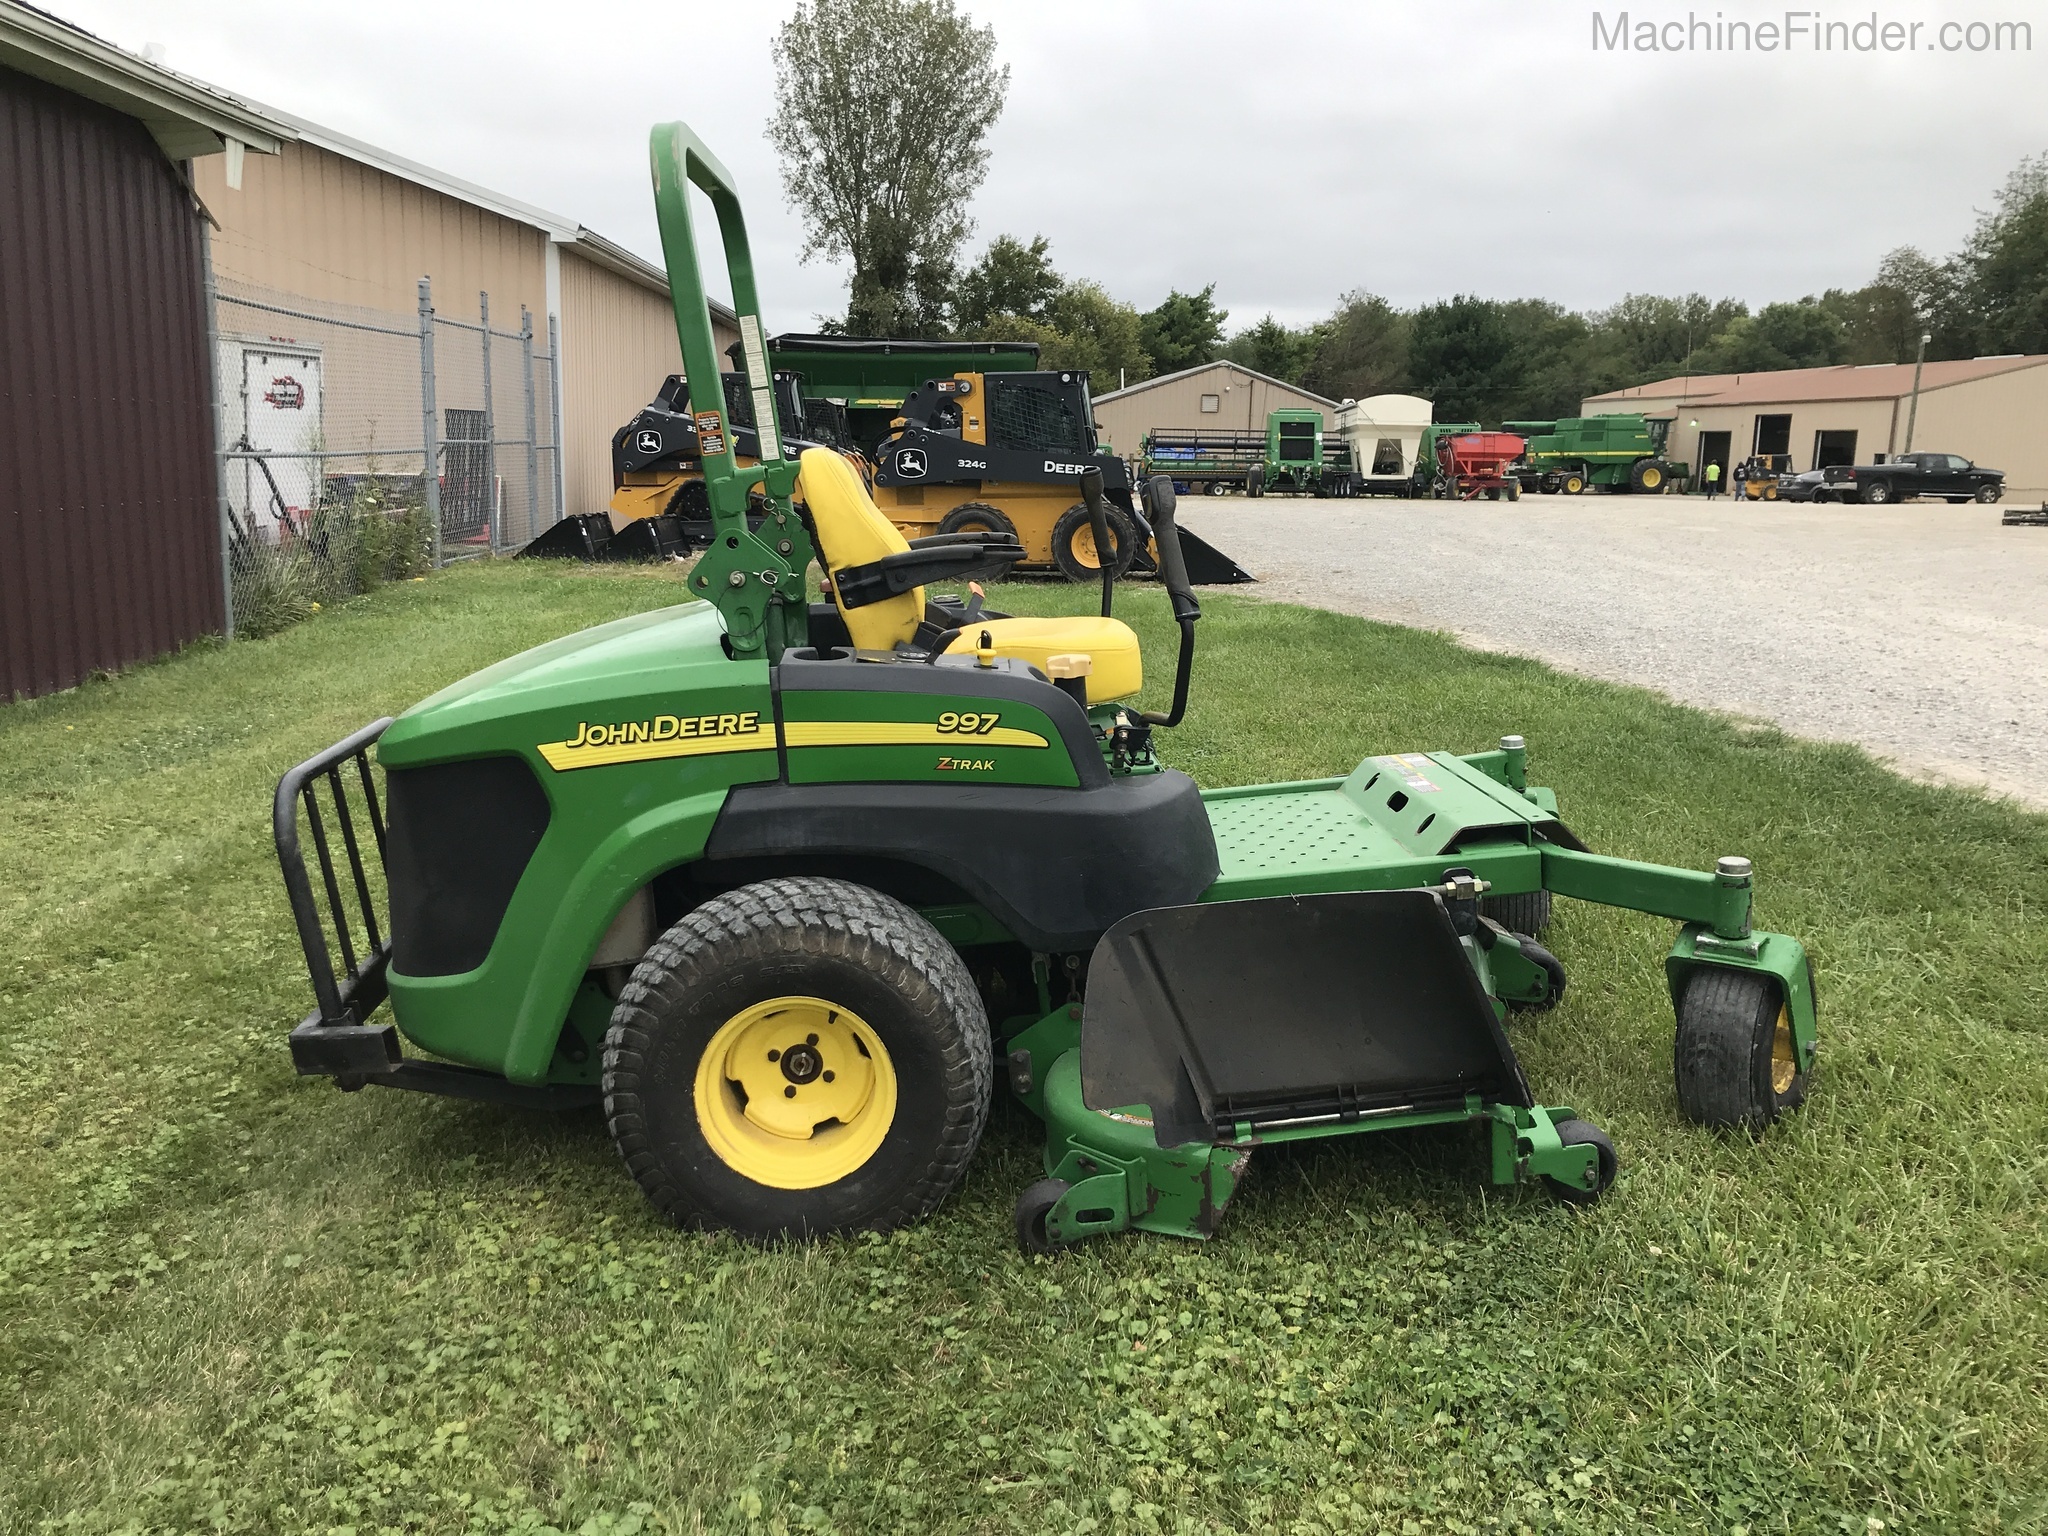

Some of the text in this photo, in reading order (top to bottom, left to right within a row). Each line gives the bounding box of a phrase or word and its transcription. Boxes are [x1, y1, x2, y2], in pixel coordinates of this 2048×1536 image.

[957, 459, 987, 469] 324G
[566, 712, 759, 748] JOHN DEERE
[937, 711, 1001, 734] 997
[936, 757, 996, 771] ZTRAK
